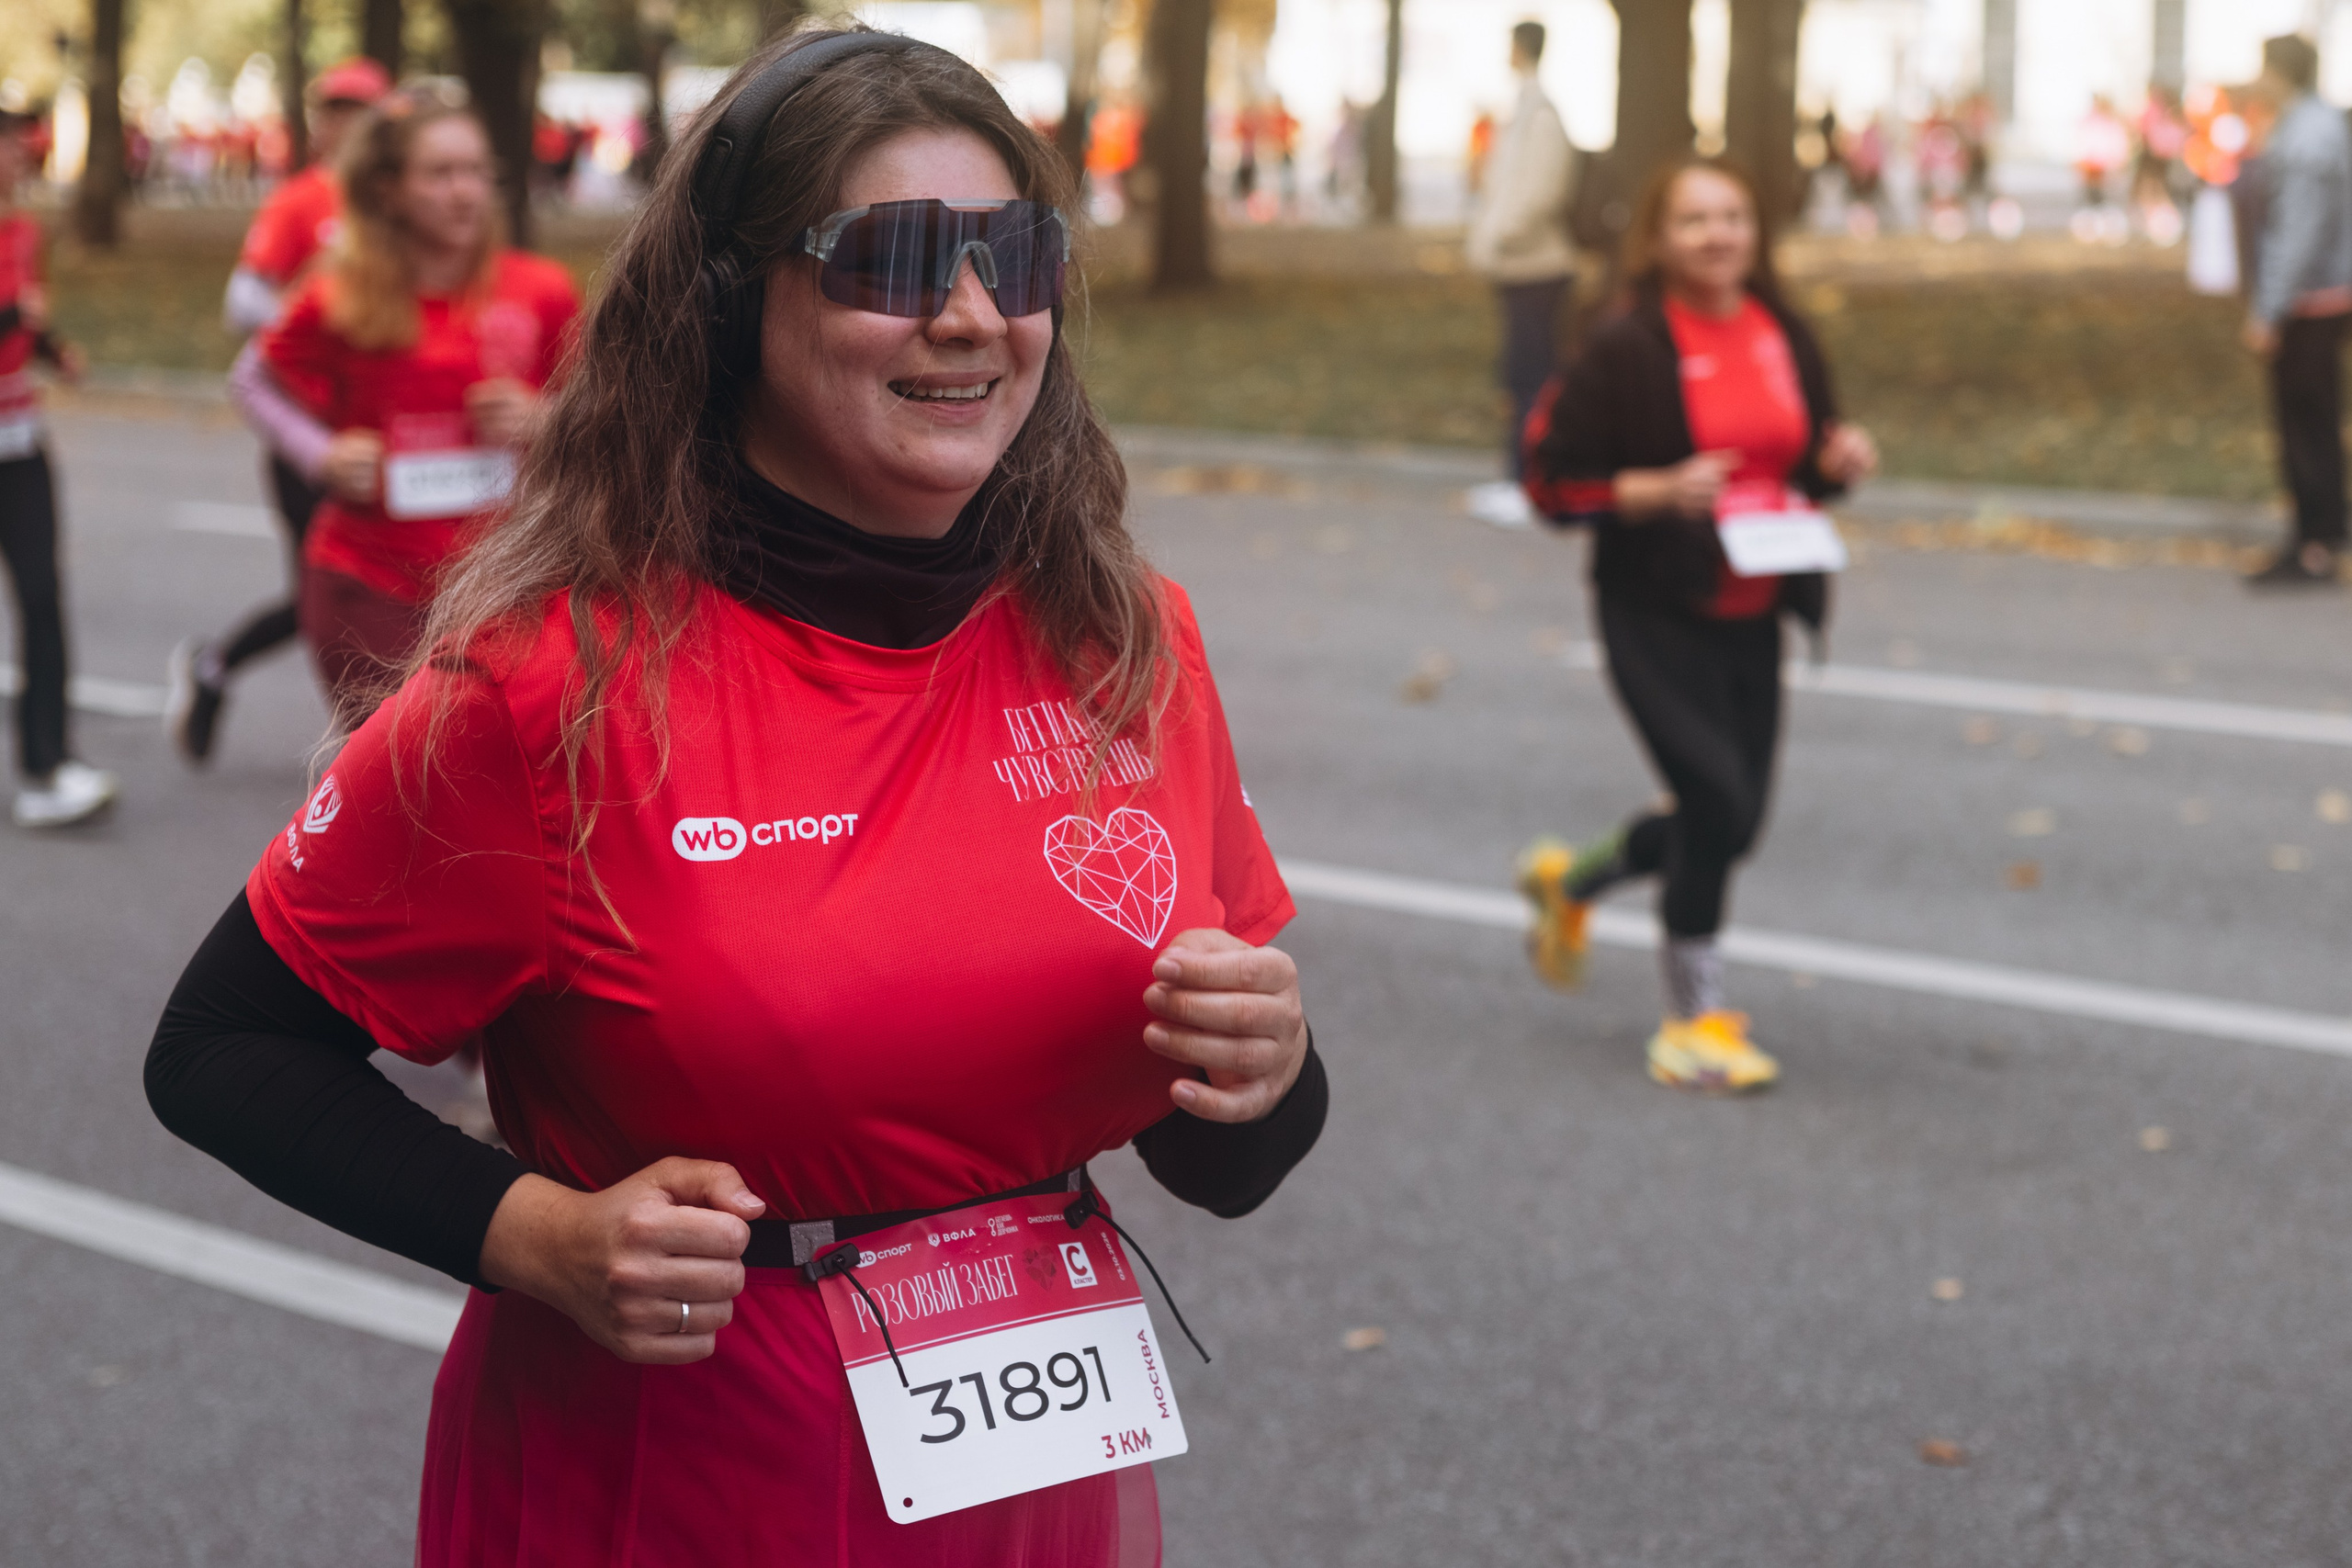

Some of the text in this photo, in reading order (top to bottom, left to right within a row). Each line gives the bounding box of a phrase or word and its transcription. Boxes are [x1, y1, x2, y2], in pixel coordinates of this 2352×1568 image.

[678, 814, 859, 854] wb спорт
[877, 1243, 912, 1260] спорт
[943, 1228, 977, 1243] ВФЛА
[850, 1255, 1019, 1333] РОЗОВЫЙ ЗАБЕГ
[1137, 1328, 1170, 1419] МОСКВА
[909, 1346, 1112, 1444] 31891
[1101, 1435, 1116, 1459] 3
